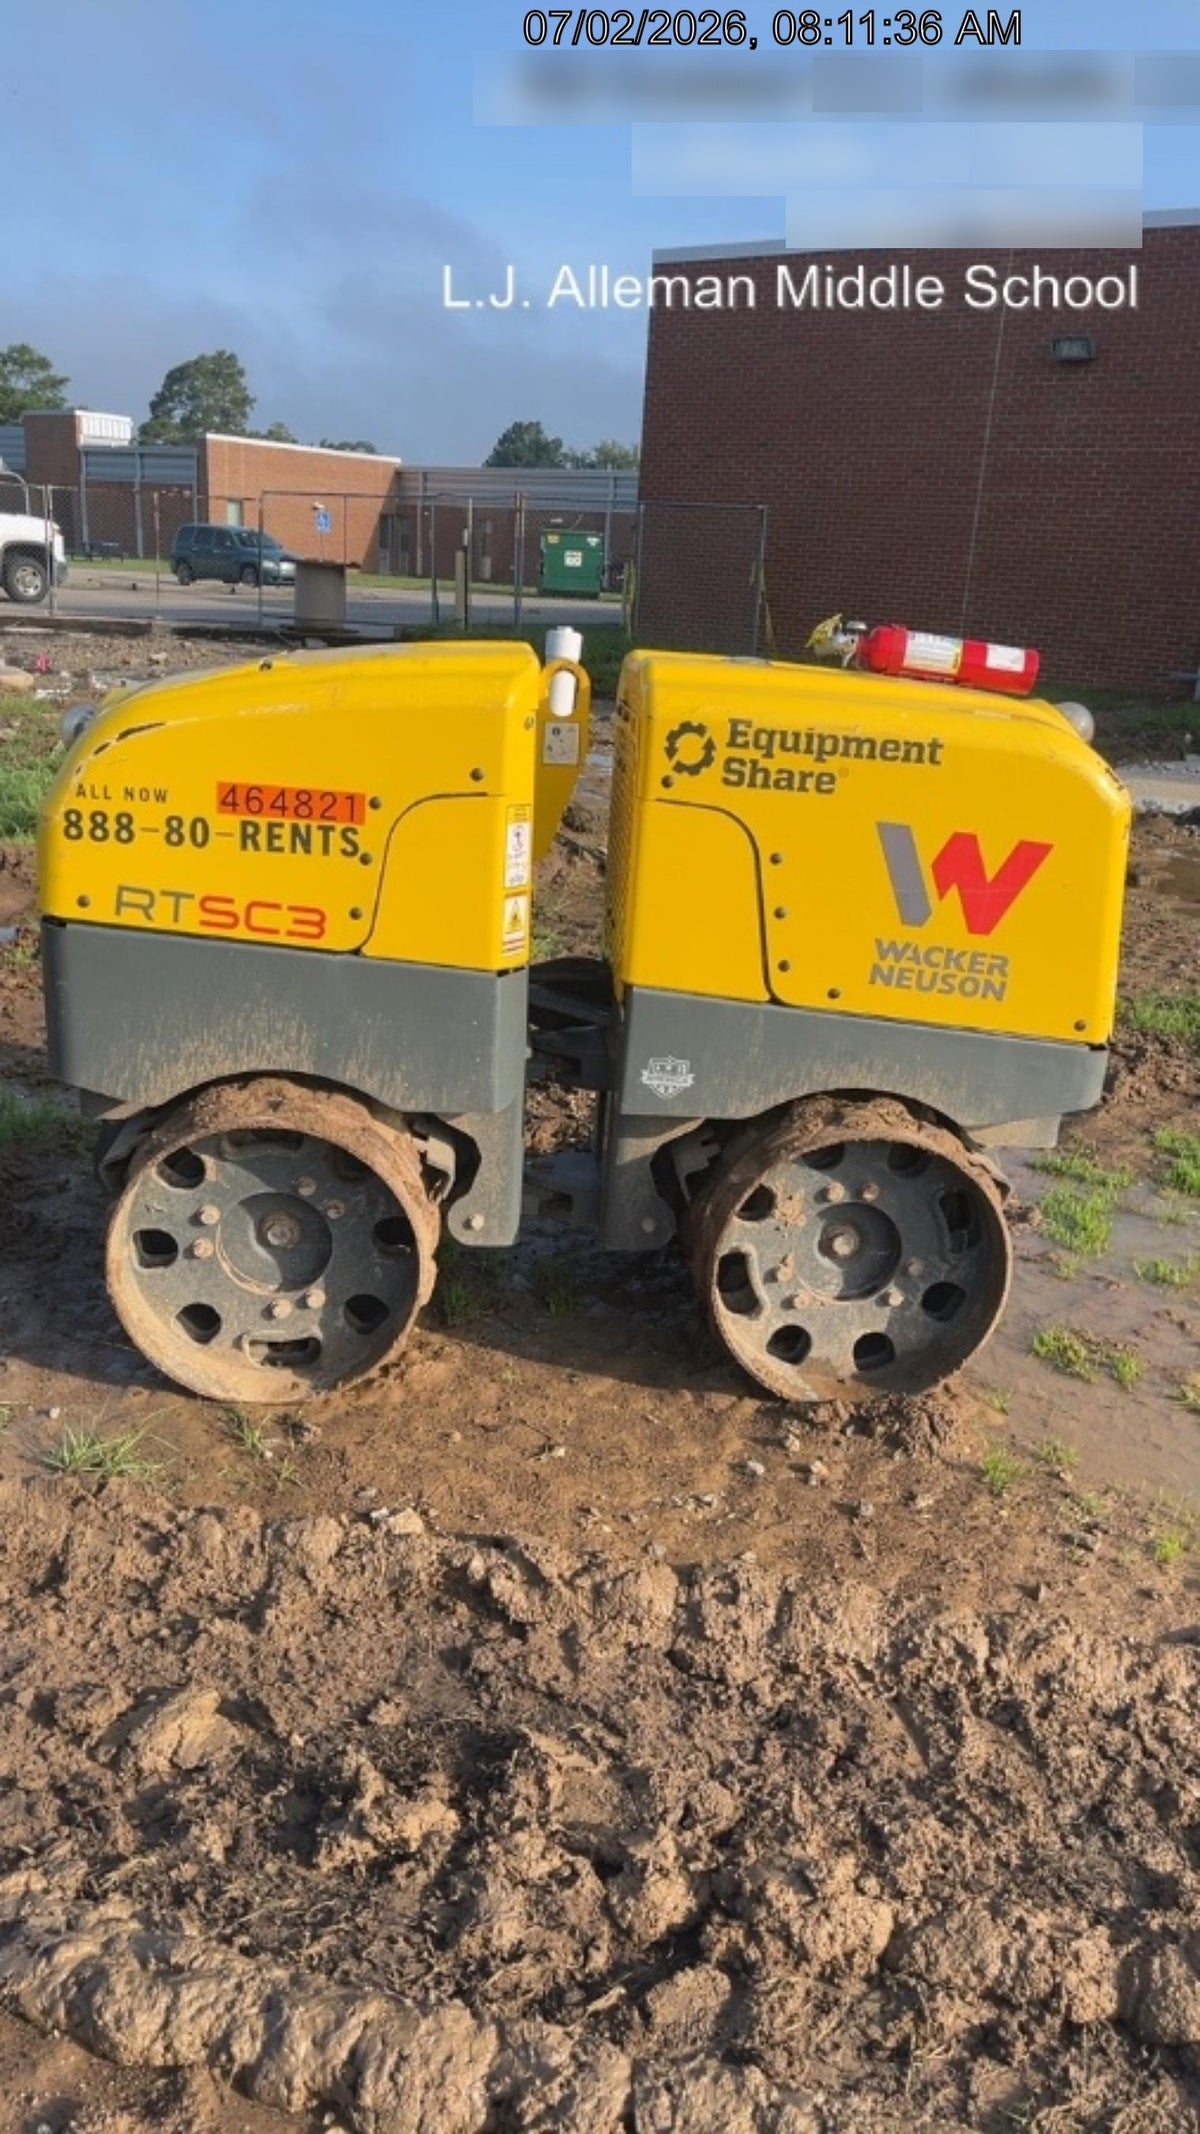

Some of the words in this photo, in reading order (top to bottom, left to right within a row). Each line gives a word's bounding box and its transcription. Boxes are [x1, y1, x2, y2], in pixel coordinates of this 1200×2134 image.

[725, 717, 944, 766] Equipment
[75, 783, 113, 801] ALL
[123, 786, 168, 804] NOW
[721, 756, 836, 795] Share
[219, 782, 357, 822] 464821
[874, 937, 1009, 978] WACKER
[868, 962, 1007, 1002] NEUSON
